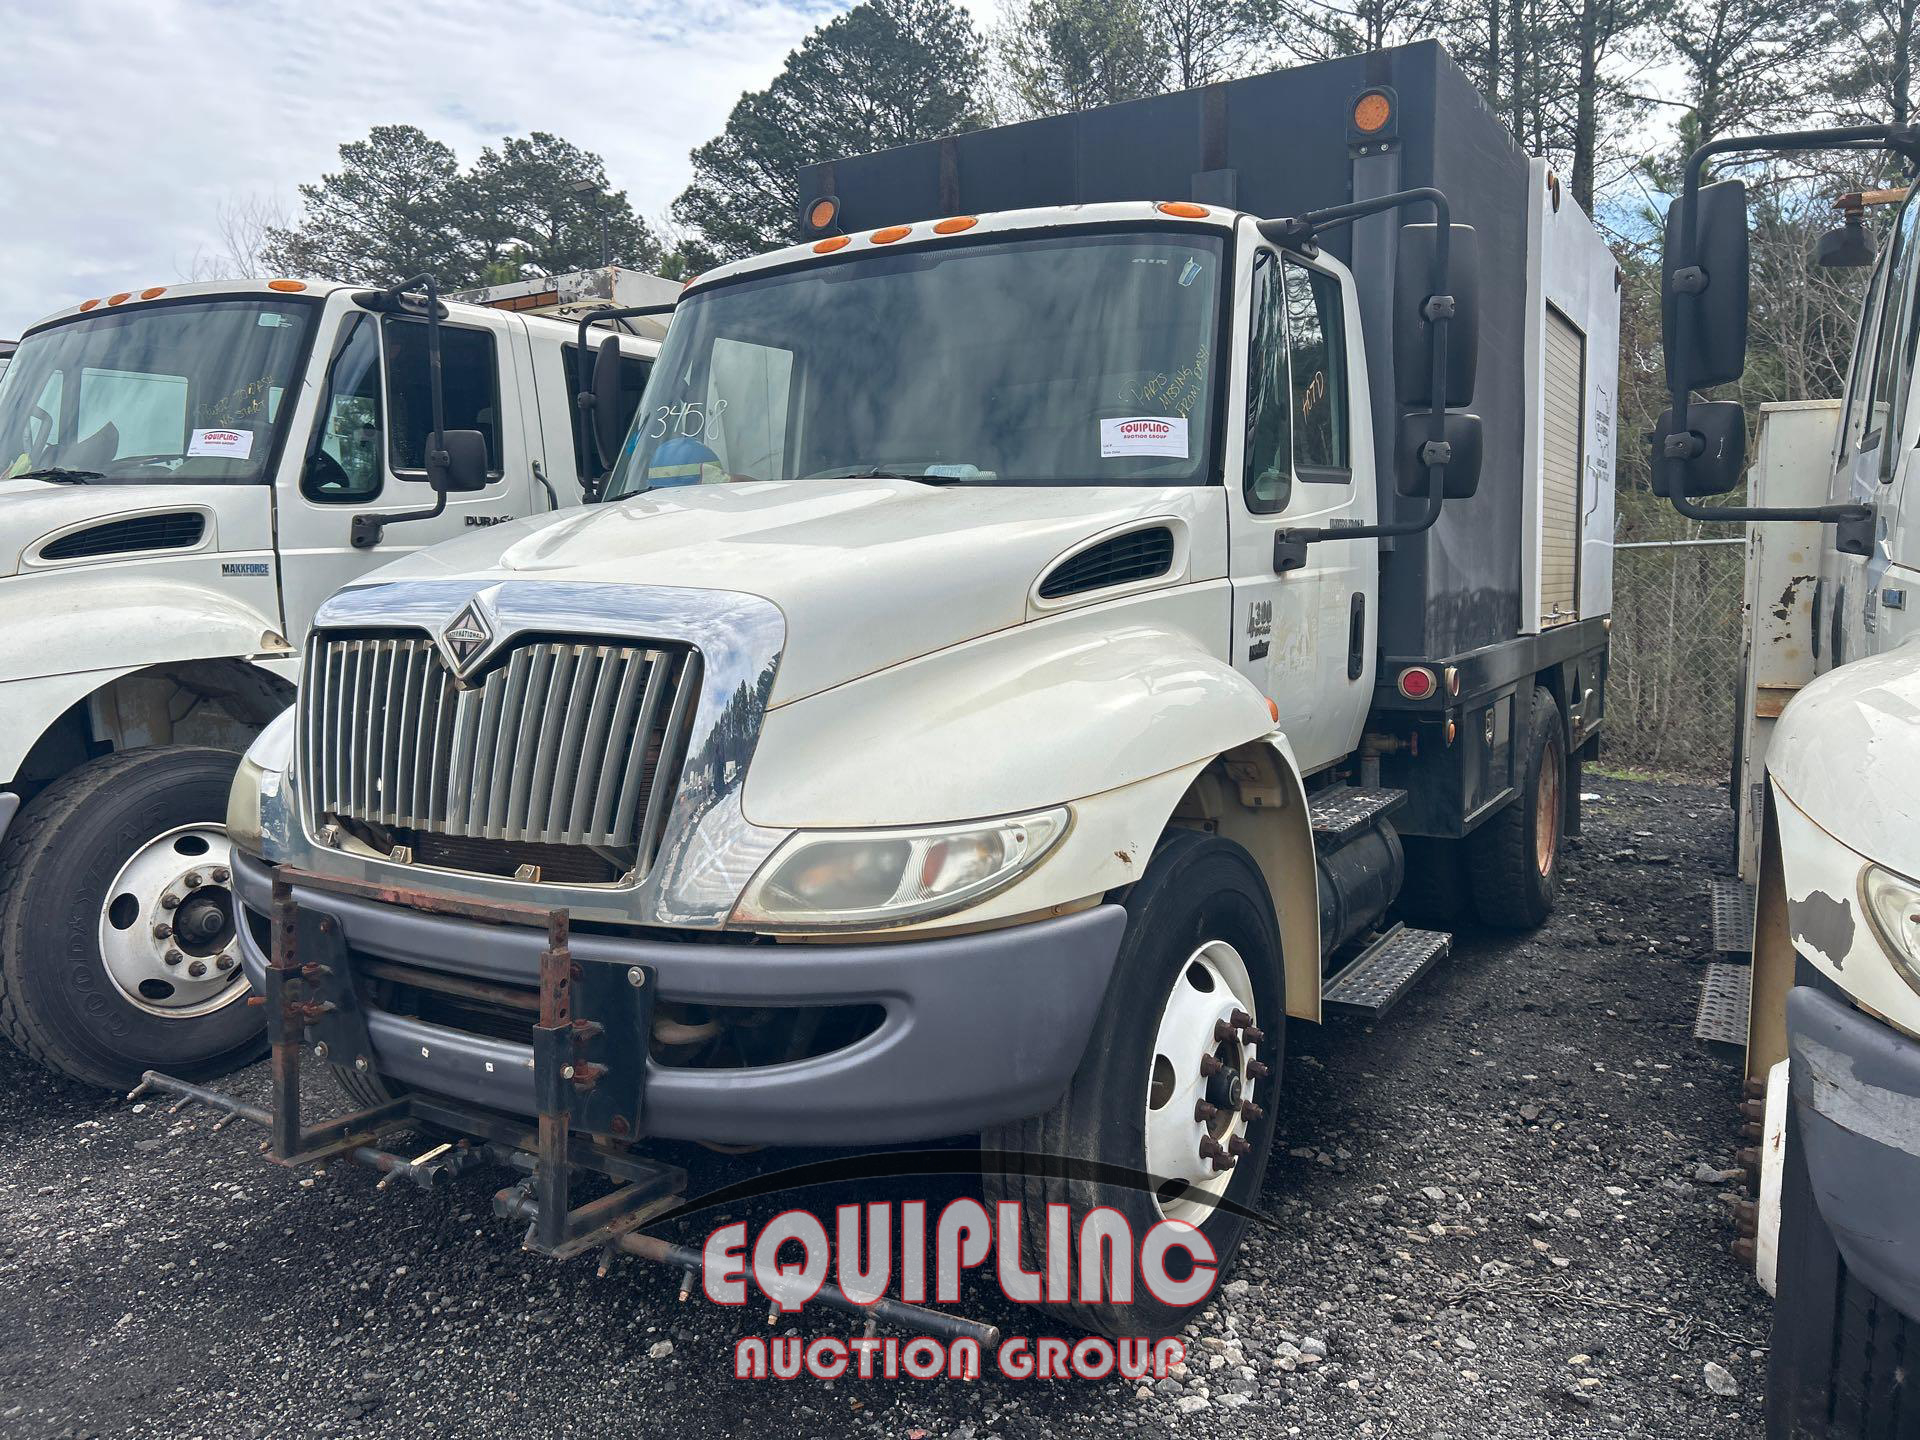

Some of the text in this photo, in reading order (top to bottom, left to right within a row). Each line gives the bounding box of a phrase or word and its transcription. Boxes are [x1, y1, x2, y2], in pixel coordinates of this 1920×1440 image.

[1118, 372, 1168, 407] PARTS
[1159, 365, 1193, 411] MISSING
[1175, 343, 1210, 419] FROM DASH
[650, 399, 728, 440] 3458
[1120, 423, 1170, 434] EQUIPLINC
[222, 563, 269, 573] MAXXFORCE
